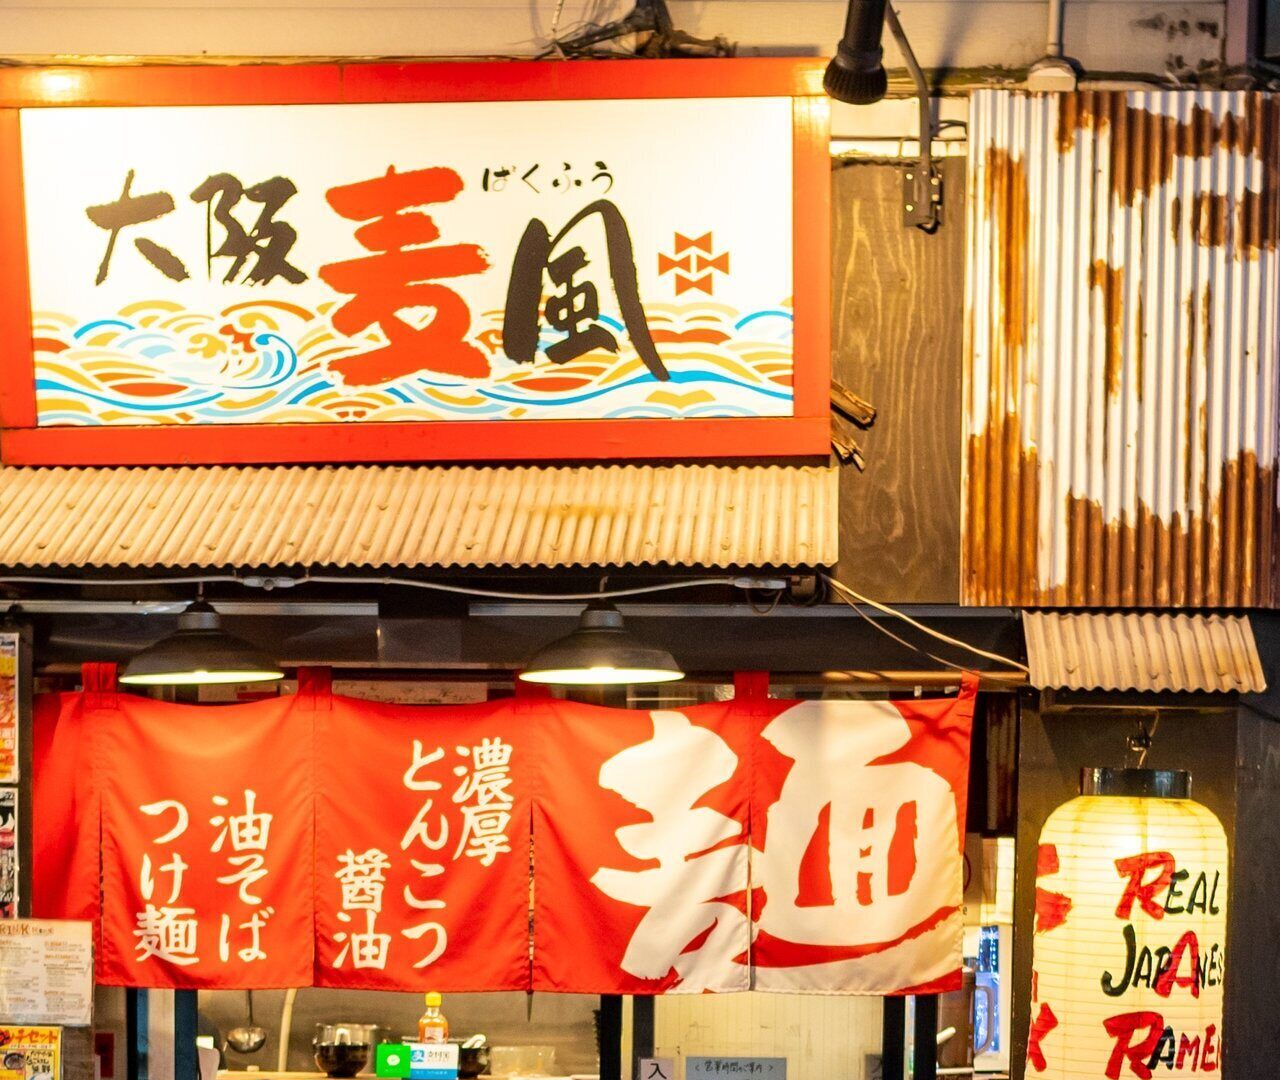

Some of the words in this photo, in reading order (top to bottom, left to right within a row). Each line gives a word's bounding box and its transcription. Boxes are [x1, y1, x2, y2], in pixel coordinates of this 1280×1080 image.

[86, 163, 670, 388] 大阪麦風
[133, 798, 200, 967] つけ麺
[210, 789, 273, 964] 油そば
[400, 739, 451, 970] とんこつ
[455, 737, 514, 867] 濃厚
[590, 700, 967, 995] 麺
[1114, 851, 1220, 921] REAL
[335, 848, 392, 971] 醤油
